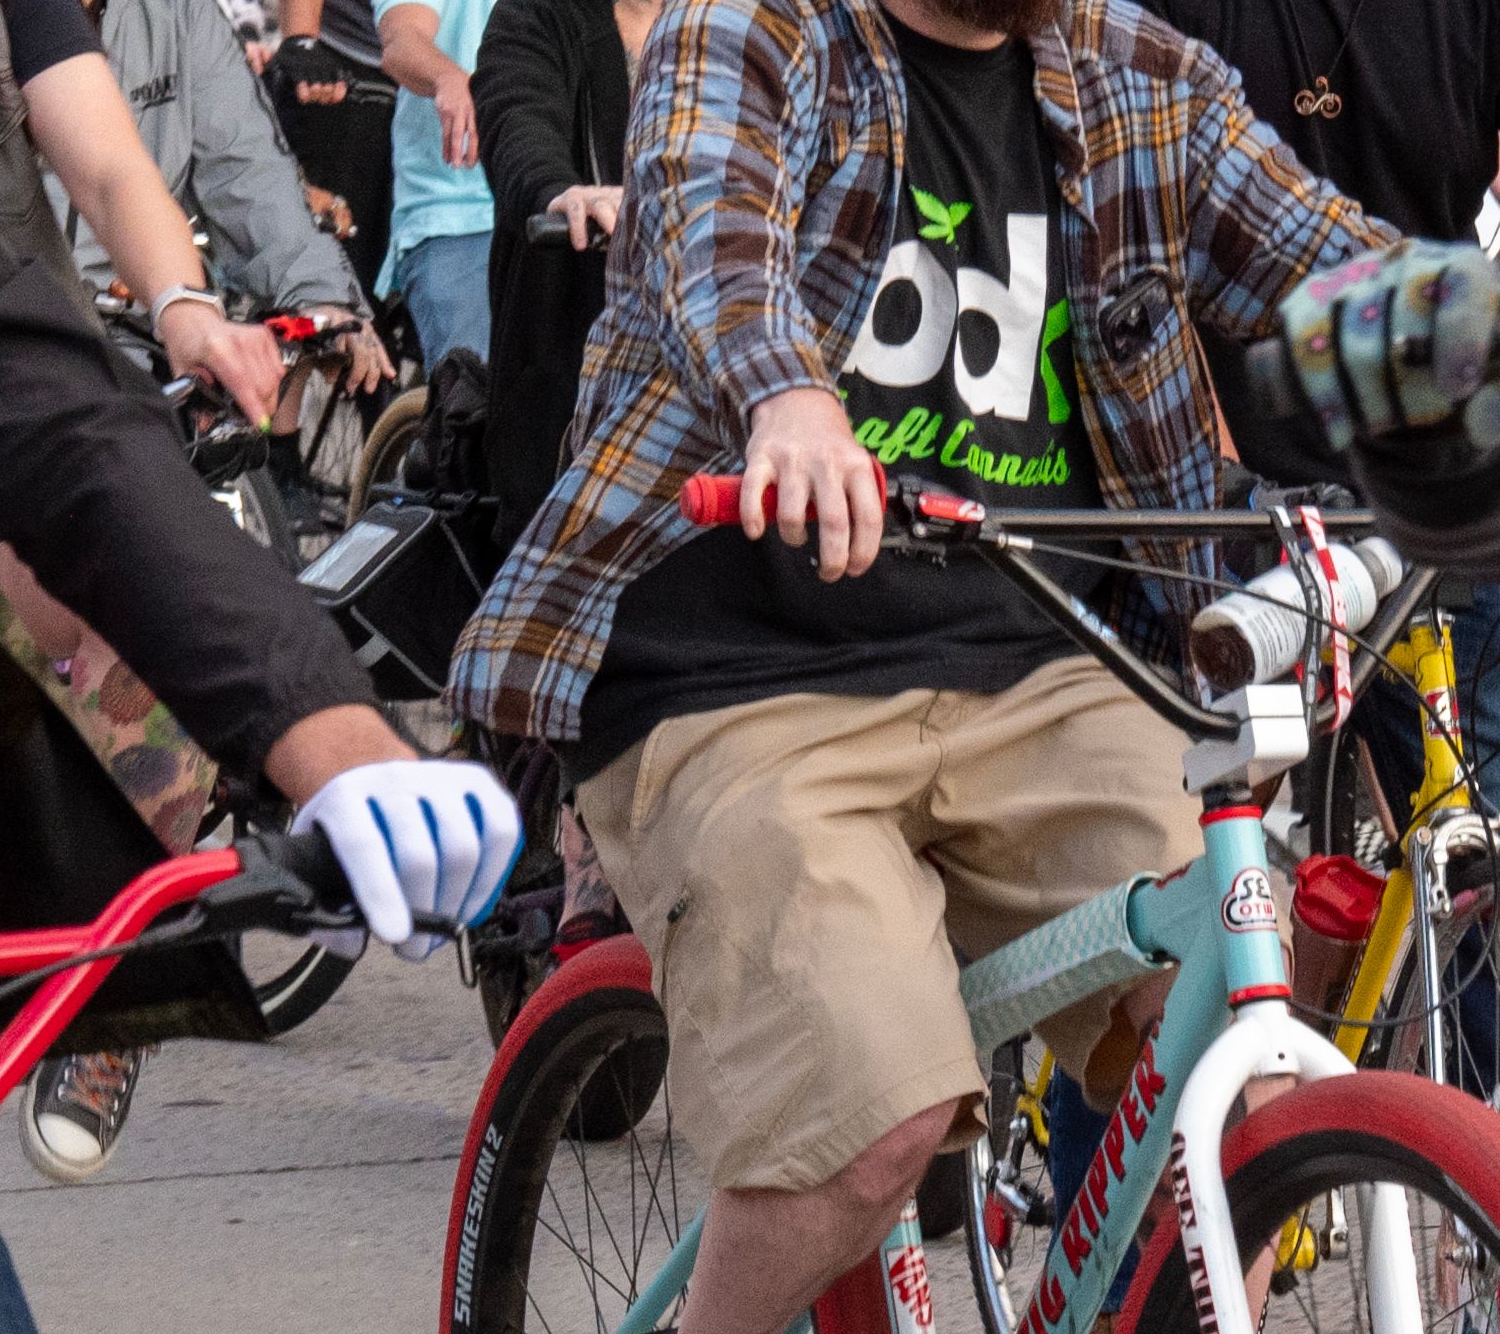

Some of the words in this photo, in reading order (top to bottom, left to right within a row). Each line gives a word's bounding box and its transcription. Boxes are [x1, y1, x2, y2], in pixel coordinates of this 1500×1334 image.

[453, 1146, 497, 1328] SNAKESKIN
[484, 1122, 504, 1152] 2
[1060, 1037, 1167, 1279] RIPPER
